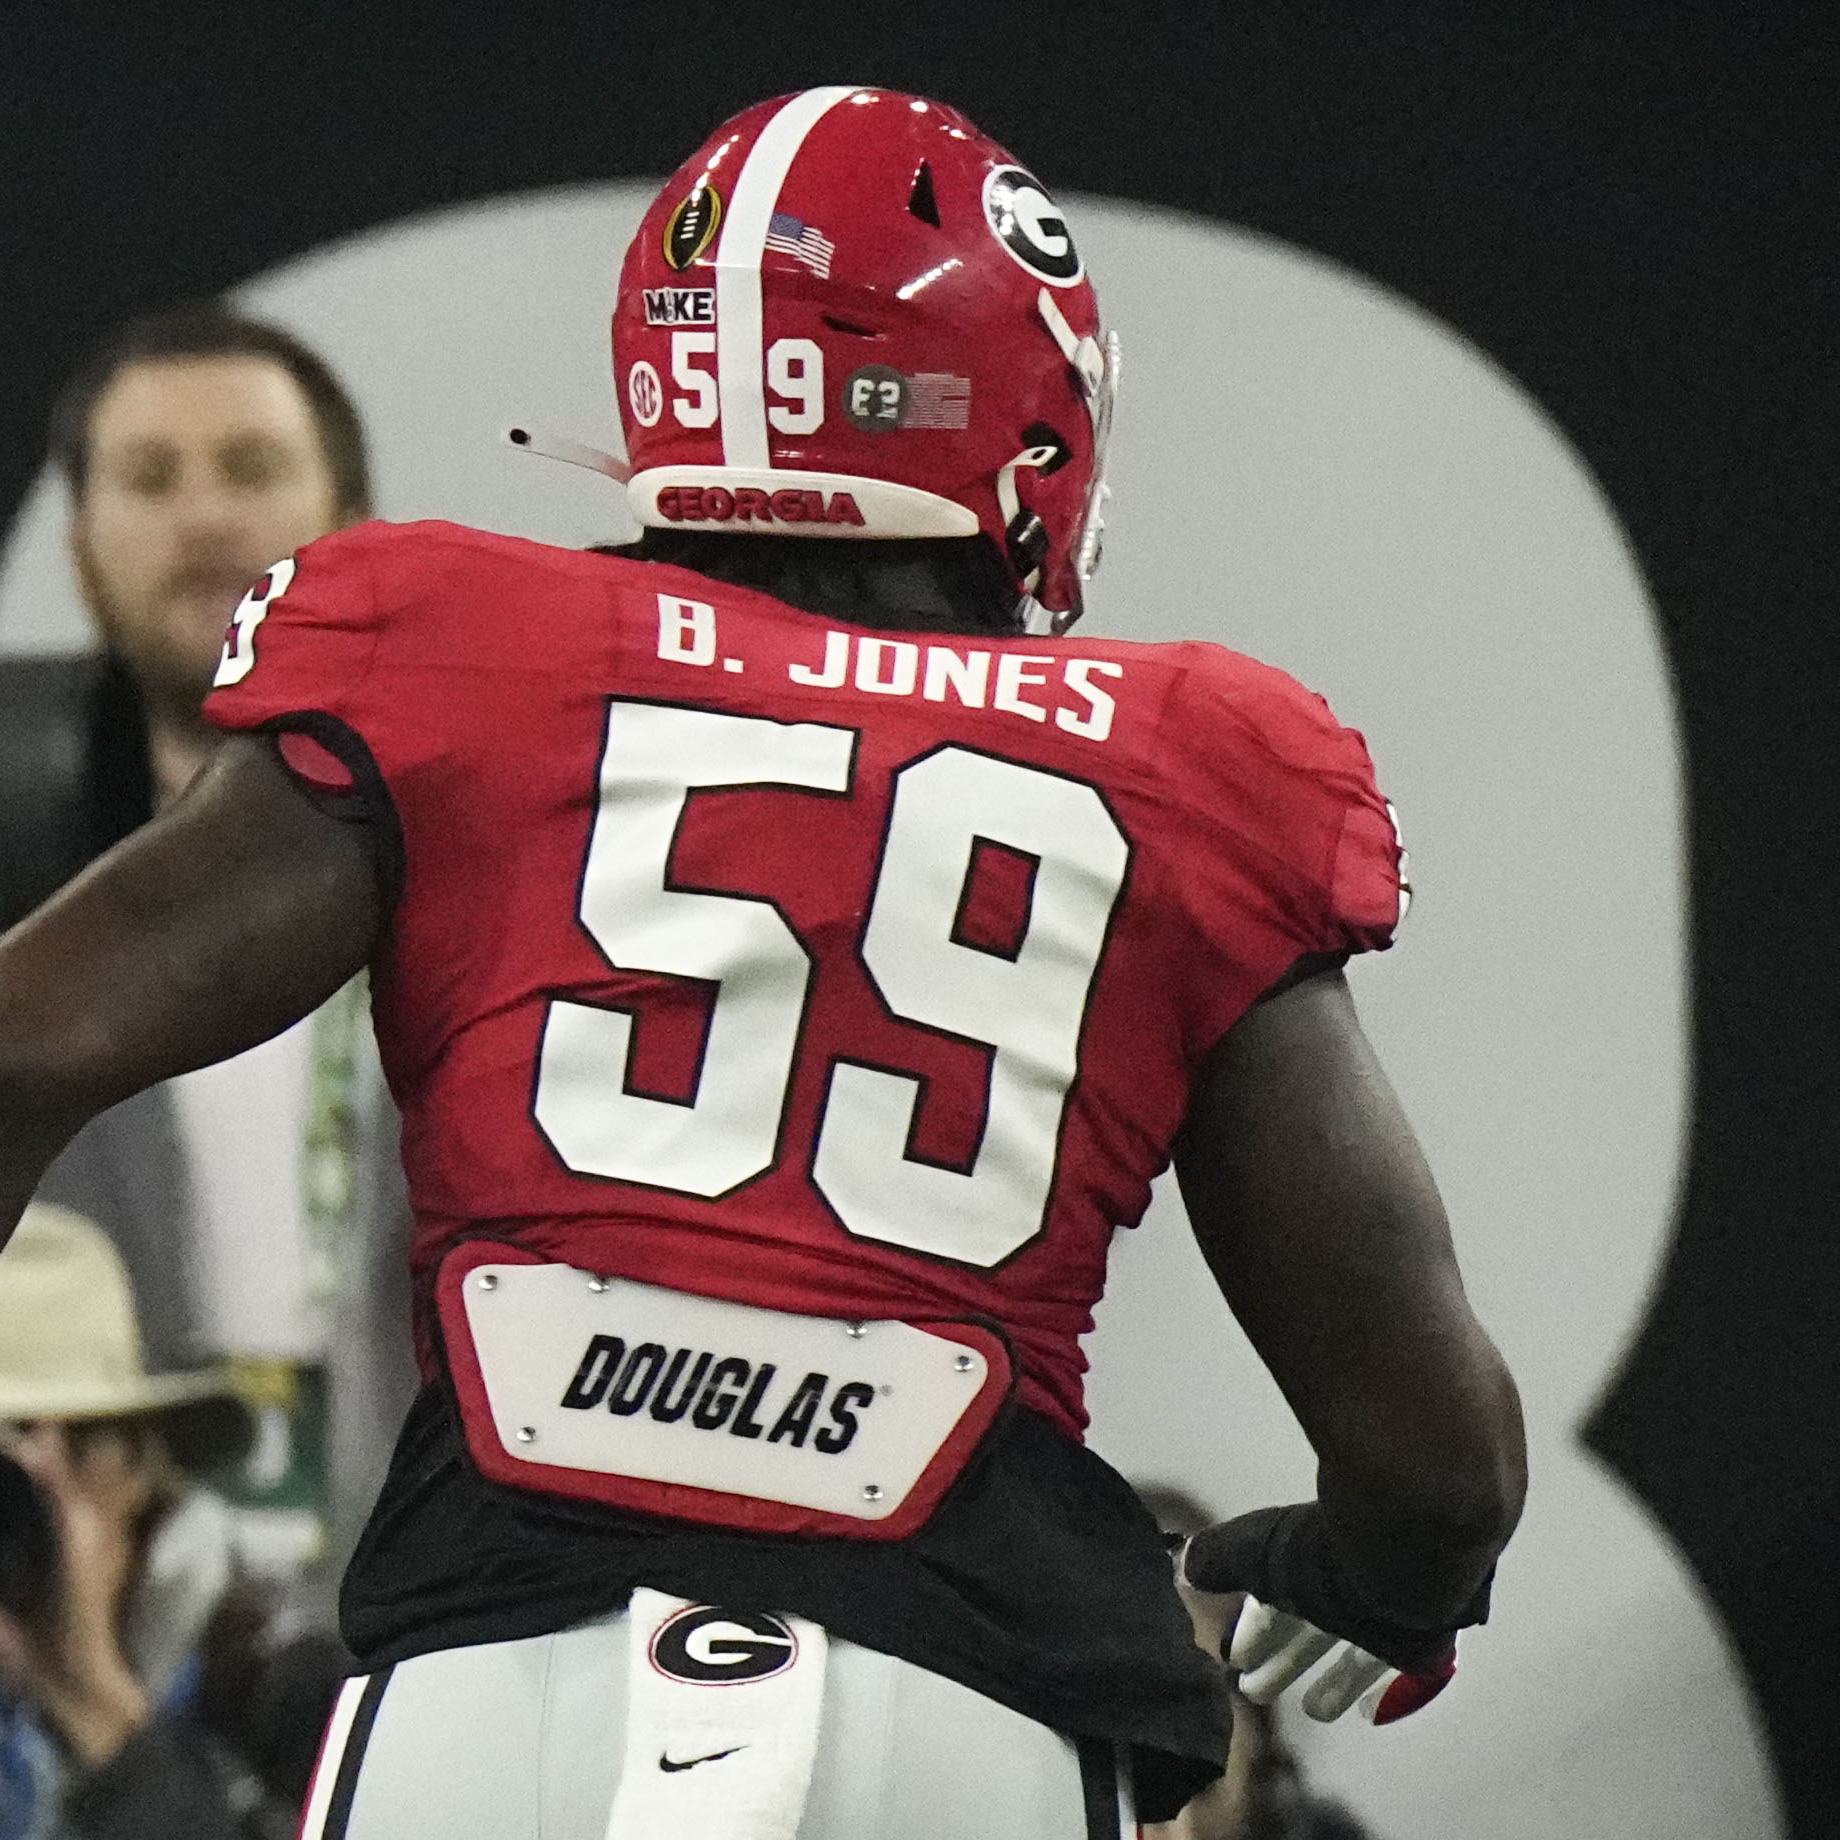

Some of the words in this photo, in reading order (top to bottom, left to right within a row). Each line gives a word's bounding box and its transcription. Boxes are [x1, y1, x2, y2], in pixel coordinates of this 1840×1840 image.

[655, 485, 866, 527] GEORGIA
[656, 593, 743, 676] B.
[788, 628, 1124, 744] JONES
[531, 699, 1133, 1271] 59
[559, 1331, 878, 1458] DOUGLAS
